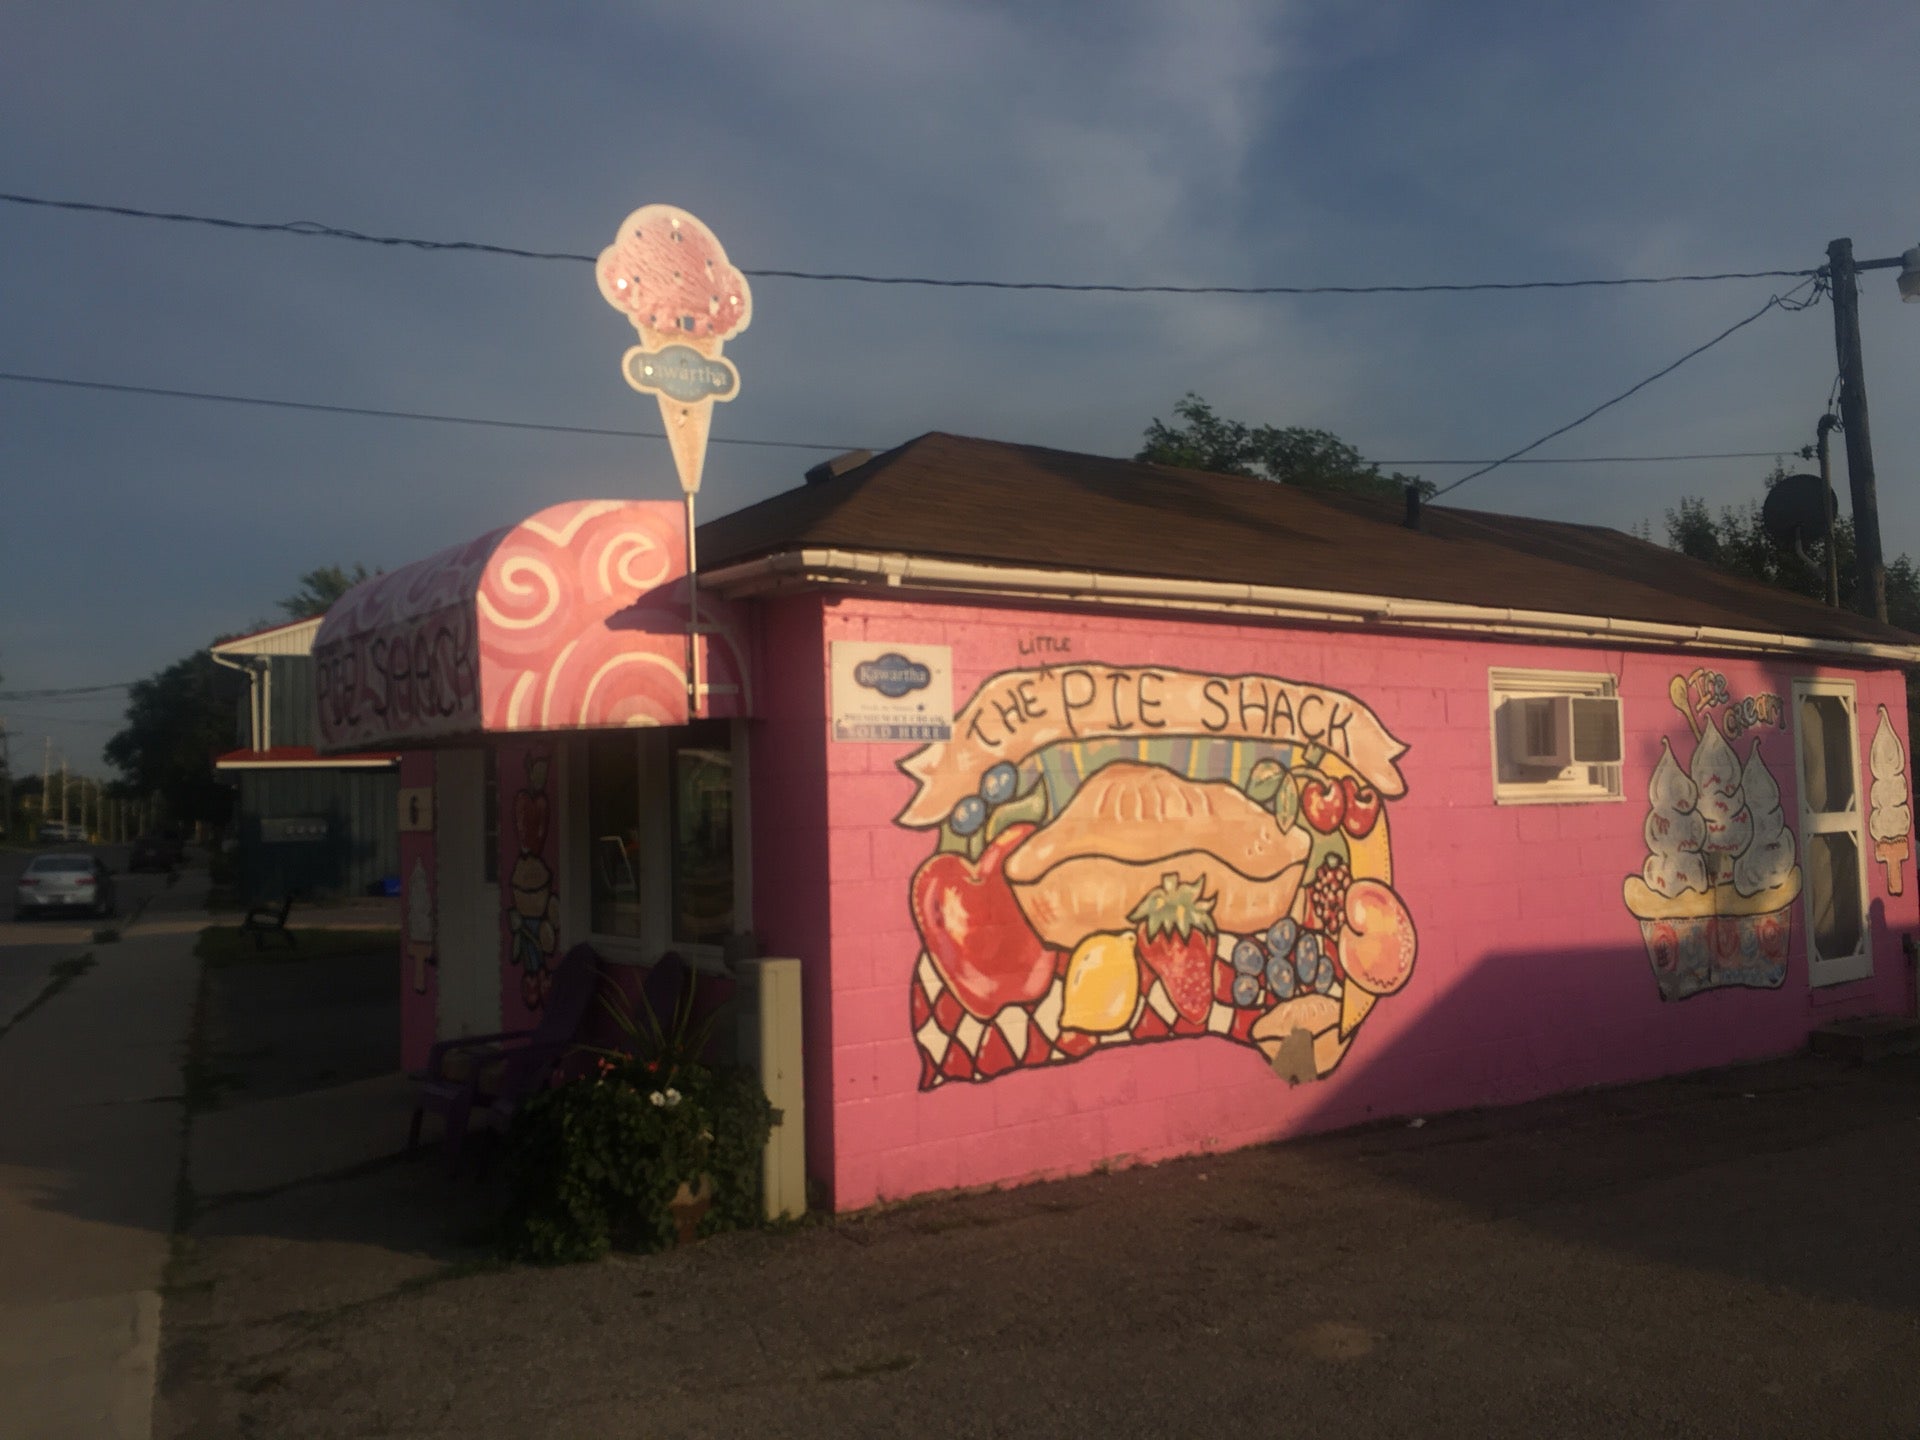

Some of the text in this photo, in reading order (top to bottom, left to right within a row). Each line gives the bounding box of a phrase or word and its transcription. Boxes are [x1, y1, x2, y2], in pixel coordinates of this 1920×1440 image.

[860, 667, 927, 683] Kawartha
[967, 670, 1353, 757] THE PIE SHACK
[847, 726, 892, 738] OLD
